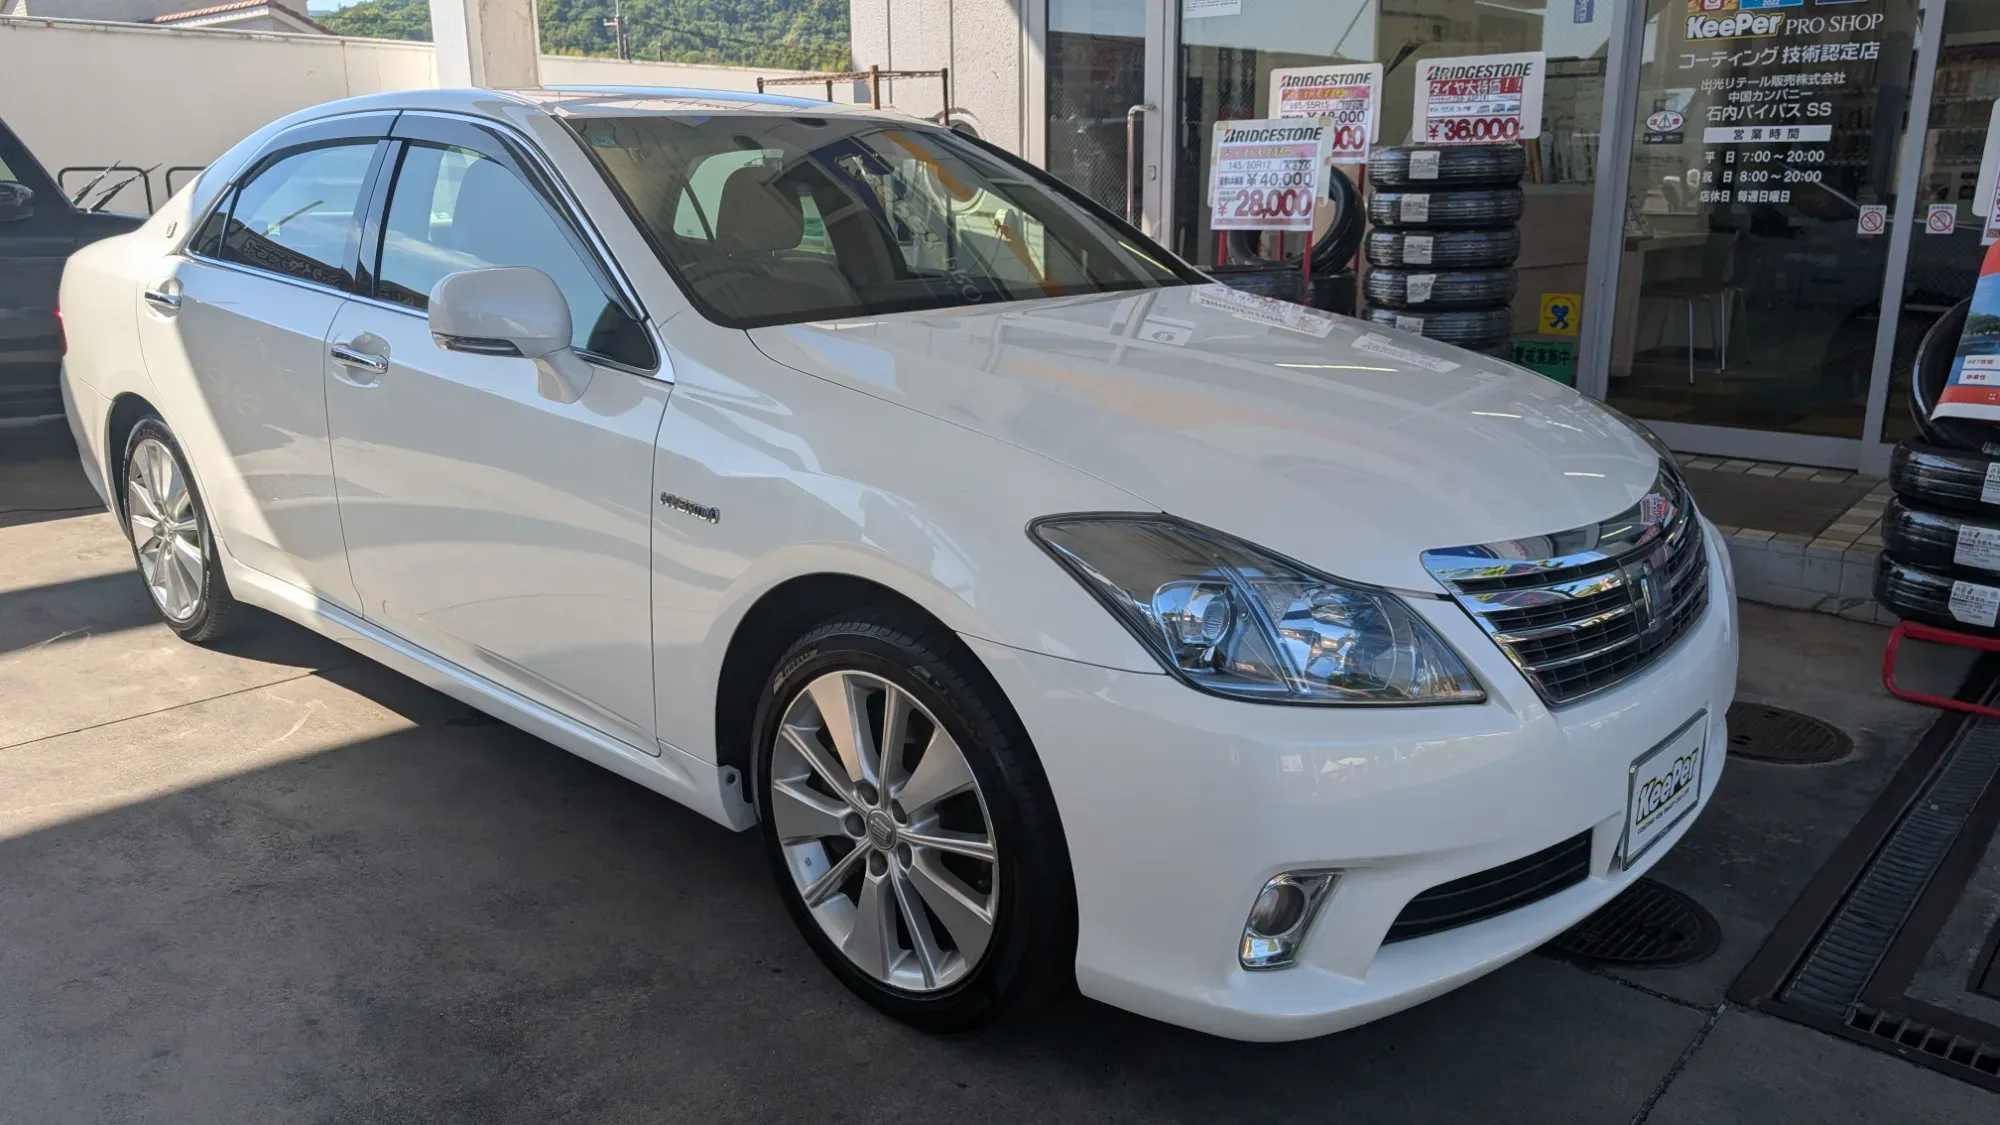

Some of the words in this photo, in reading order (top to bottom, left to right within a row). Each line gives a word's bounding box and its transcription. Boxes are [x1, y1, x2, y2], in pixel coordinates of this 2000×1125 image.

[1687, 13, 1782, 38] KeePer
[1785, 18, 1825, 35] PRO
[1829, 14, 1883, 33] SHOP
[1679, 46, 1779, 69] コーティング
[1782, 42, 1880, 65] 技術認定店
[1280, 72, 1372, 88] BRIDGESTONE
[1426, 62, 1533, 80] BRIDGESTONE
[1701, 72, 1846, 91] 出光リテール販売株式会社
[1706, 103, 1800, 121] 石内バイパス
[1806, 102, 1831, 117] SS
[1223, 127, 1323, 143] BRIDGESTONE
[1733, 127, 1800, 140] 営業時間
[1699, 190, 1730, 202] 店休日
[1636, 748, 1699, 826] KeePer
